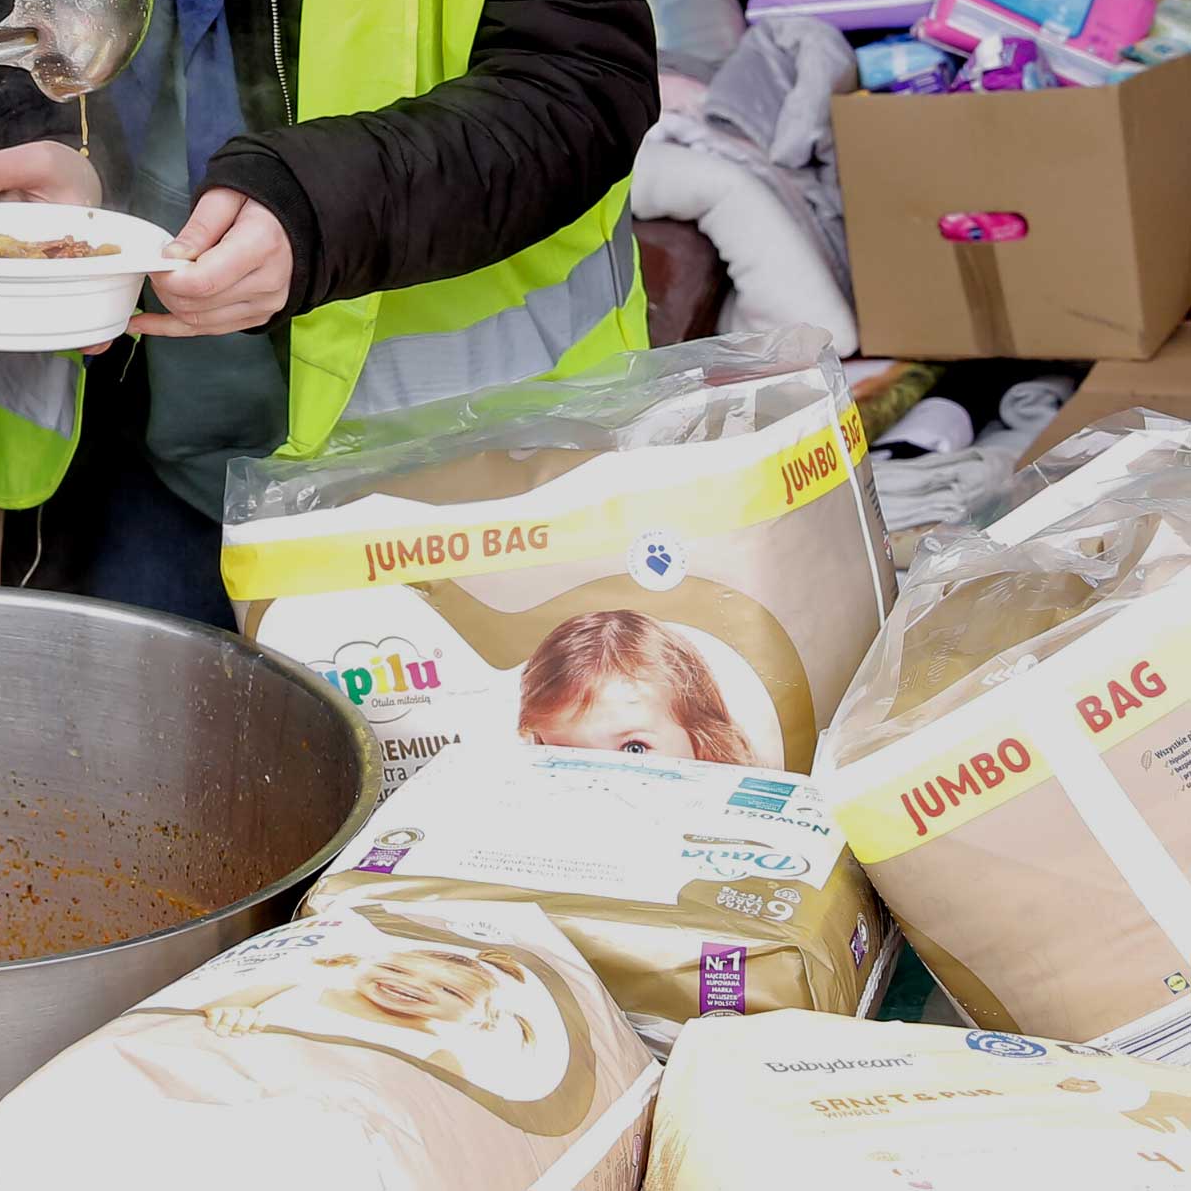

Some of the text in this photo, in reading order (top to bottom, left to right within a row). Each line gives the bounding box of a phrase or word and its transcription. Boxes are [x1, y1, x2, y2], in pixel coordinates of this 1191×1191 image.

[781, 414, 862, 505] JUMBO BAG
[365, 524, 550, 582] JUMBO BAG
[371, 698, 395, 708] Otula
[380, 733, 462, 762] EMIU
[900, 660, 1168, 837] JUMBO BAG
[1154, 737, 1188, 760] Wszystkie
[762, 900, 793, 922] 6
[765, 1055, 913, 1074] Babydream
[810, 1092, 912, 1112] SANFT
[940, 1087, 1004, 1100] PUR
[1136, 1151, 1186, 1172] 4
